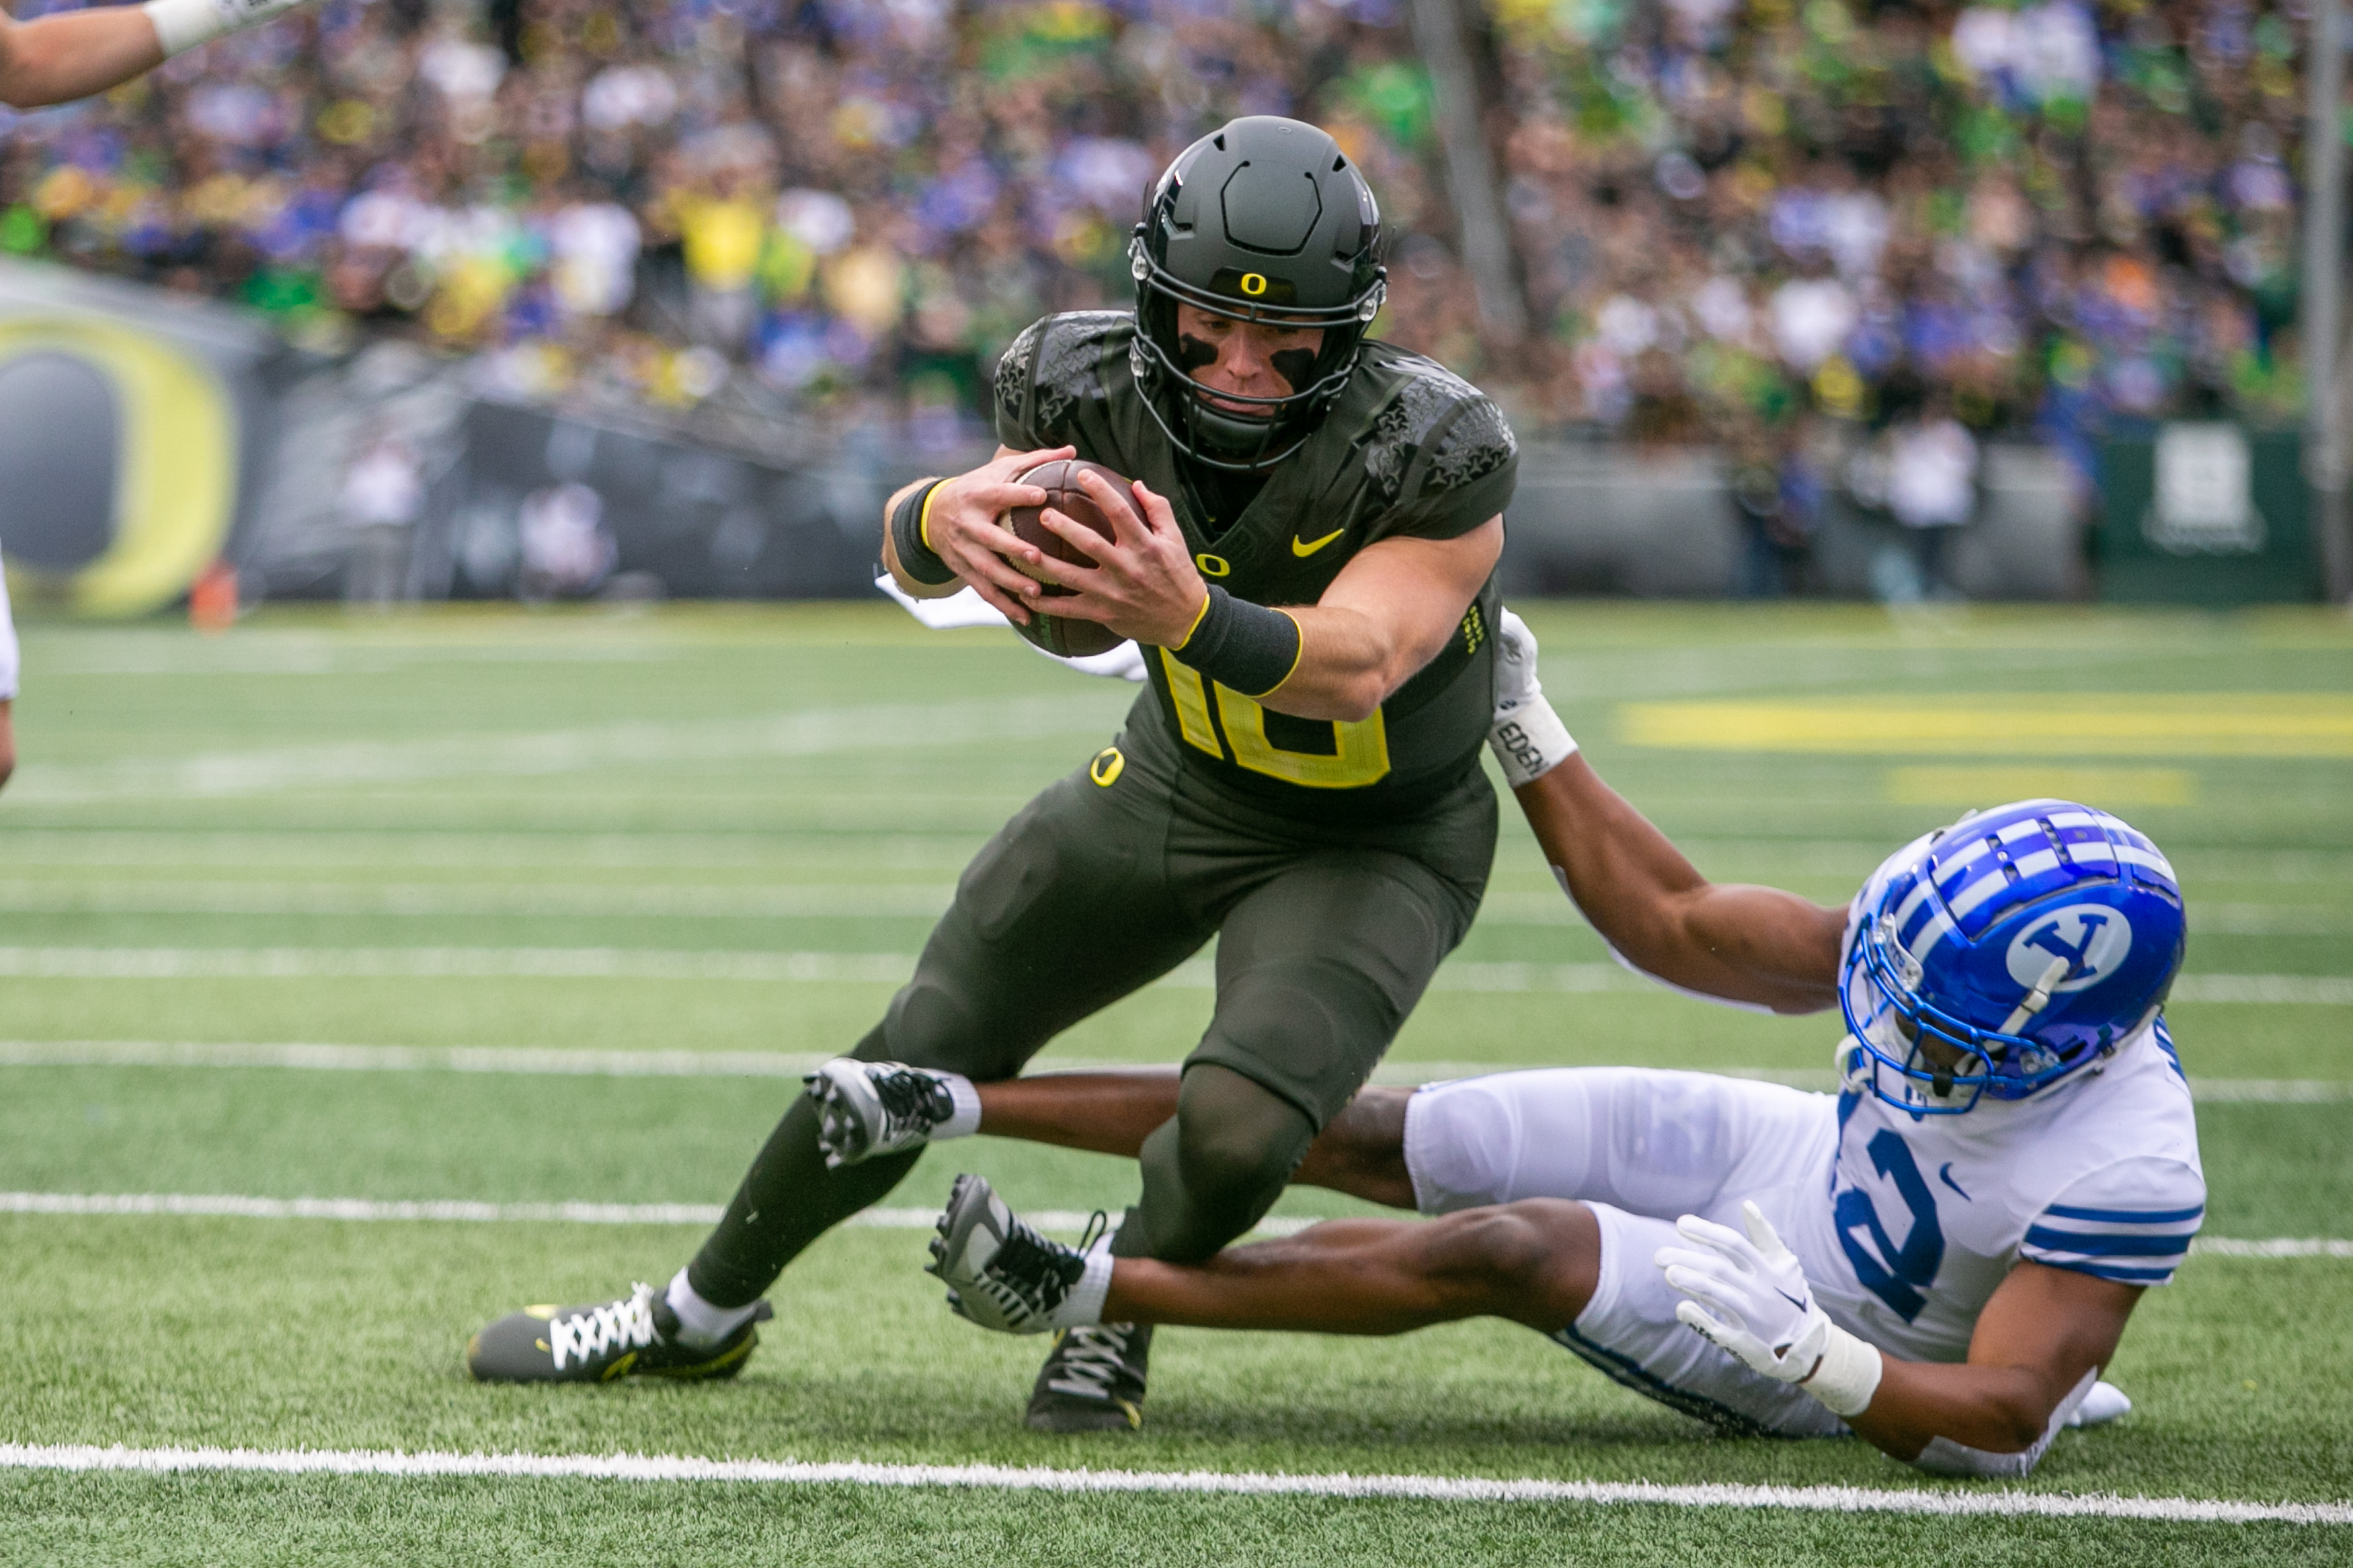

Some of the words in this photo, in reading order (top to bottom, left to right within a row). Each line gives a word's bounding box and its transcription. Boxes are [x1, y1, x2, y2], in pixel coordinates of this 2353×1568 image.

[1241, 273, 1267, 295] O
[1196, 553, 1230, 576] O
[1090, 746, 1125, 788] O
[2022, 913, 2108, 983] Y
[1829, 1085, 1946, 1324] 2
